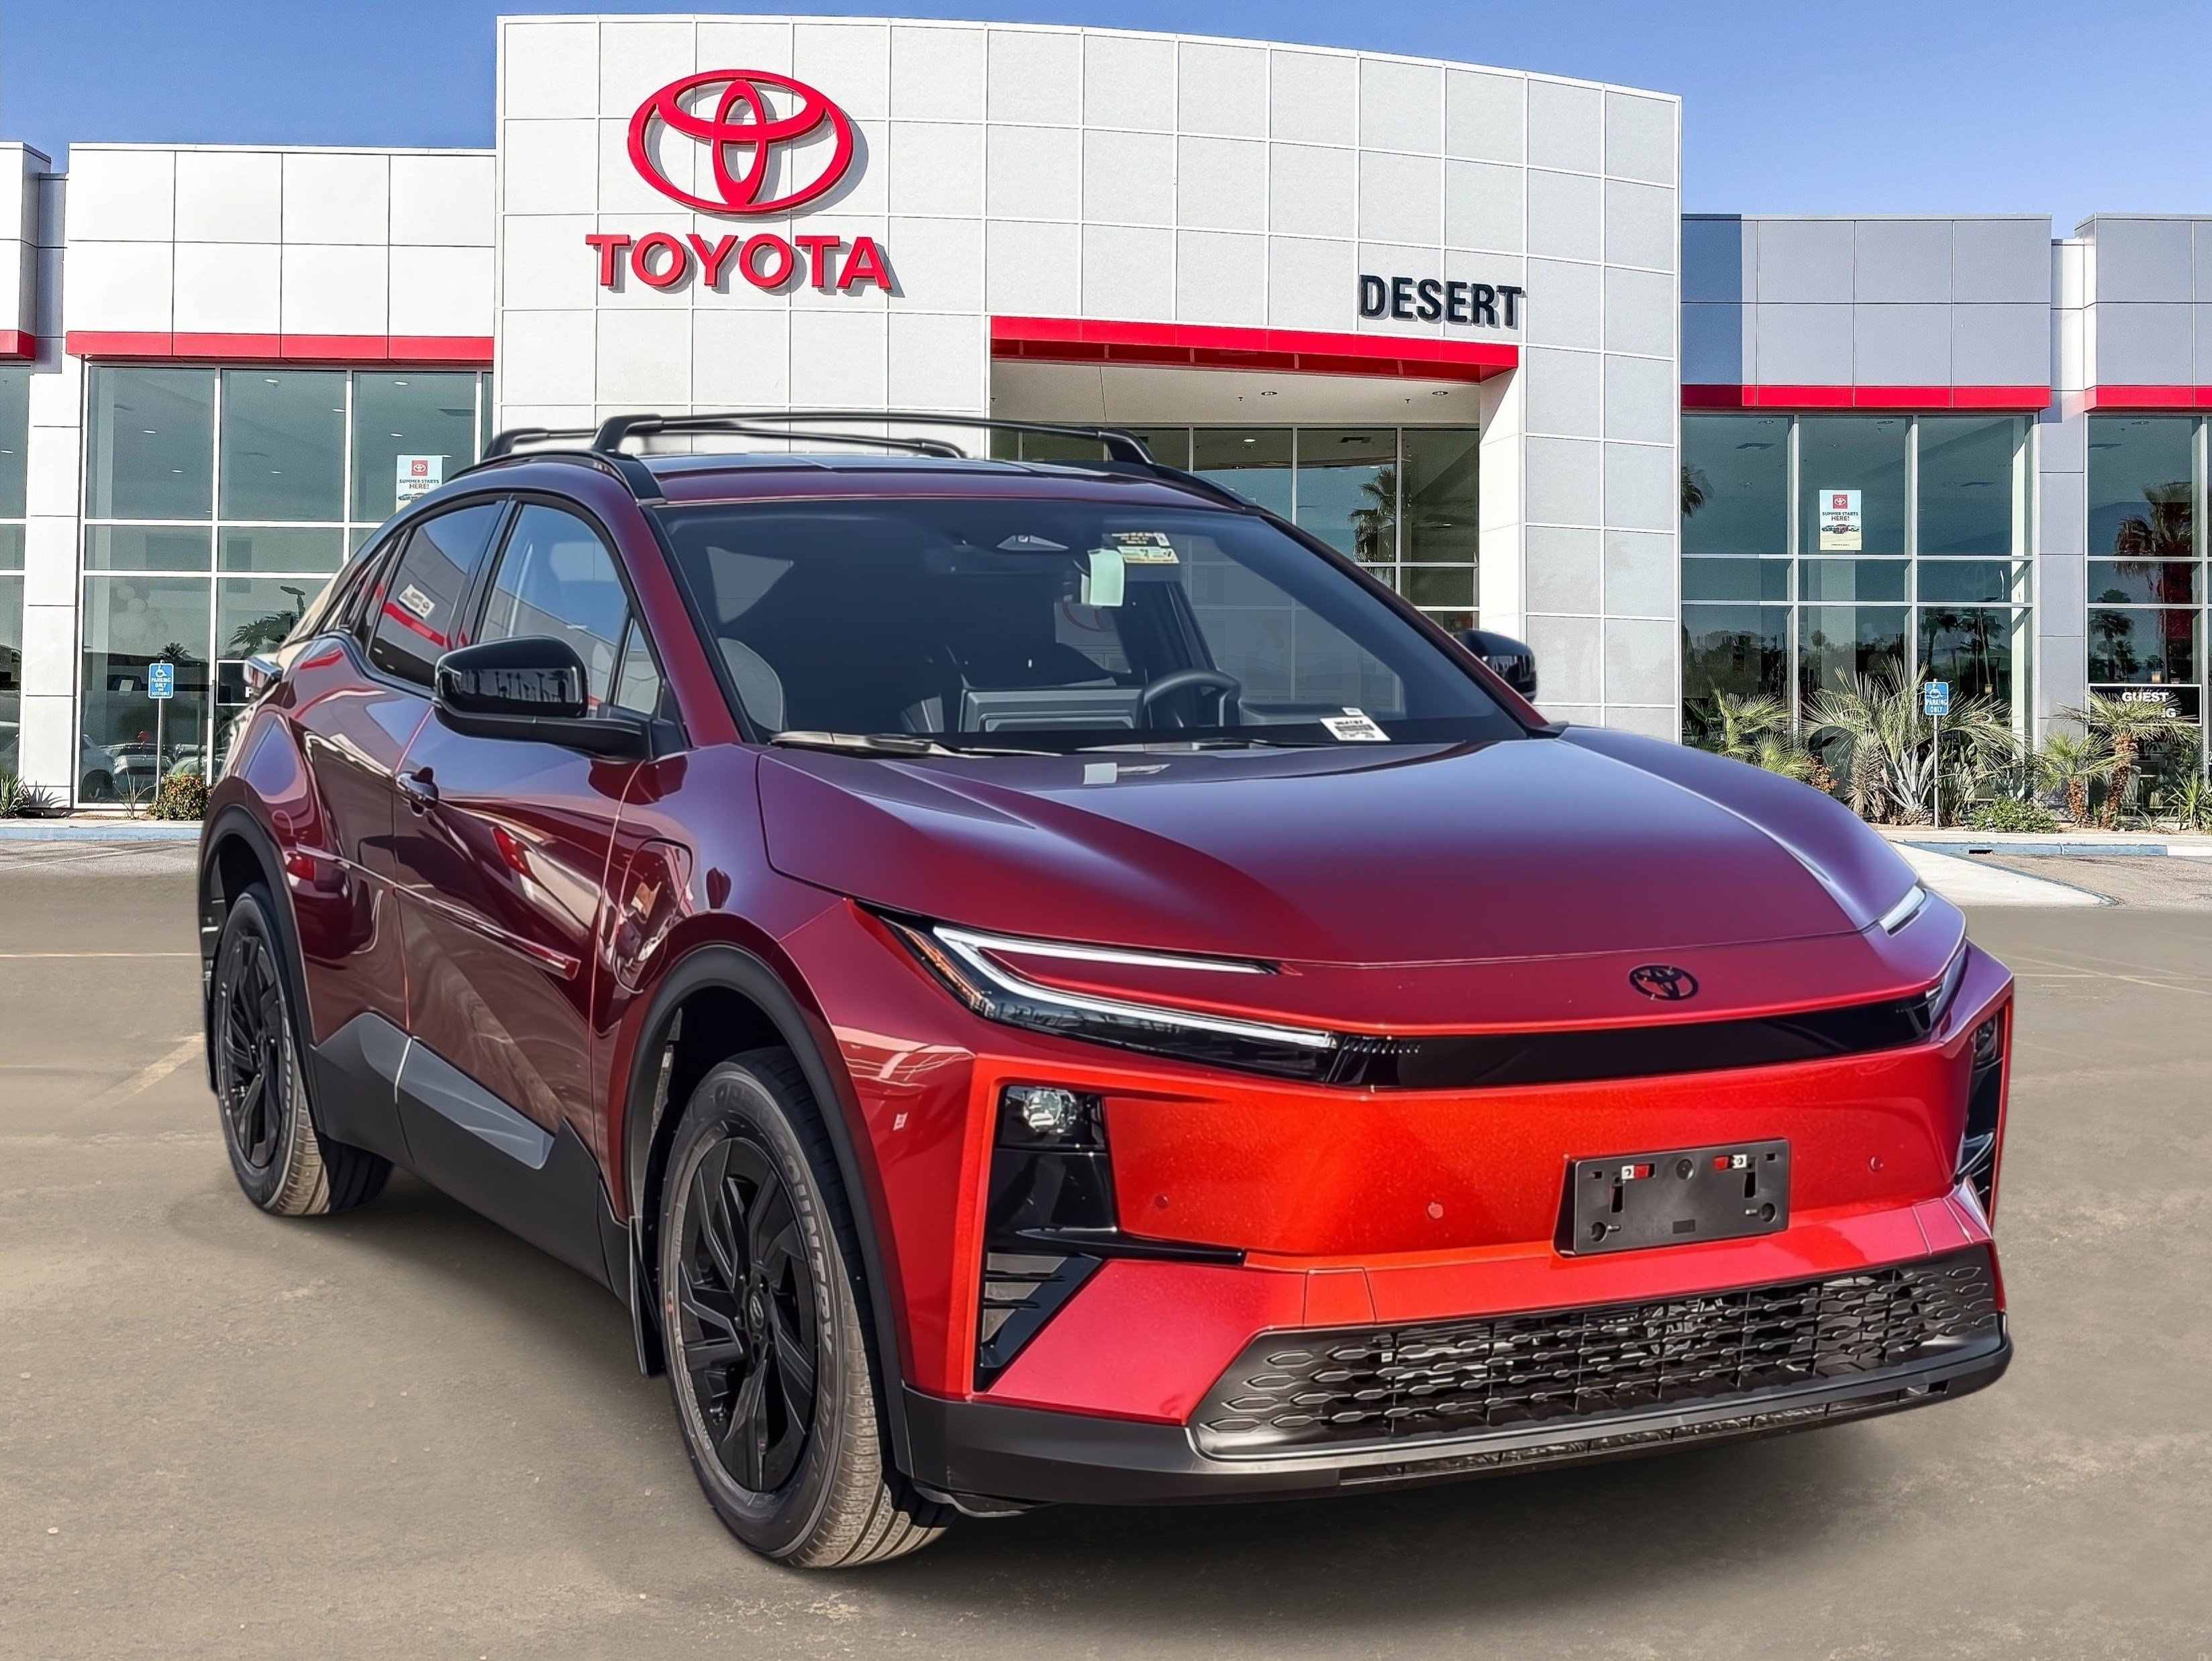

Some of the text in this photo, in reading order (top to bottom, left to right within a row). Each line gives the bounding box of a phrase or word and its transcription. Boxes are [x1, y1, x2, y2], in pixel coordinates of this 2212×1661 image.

[585, 232, 893, 291] TOYOTA
[1358, 274, 1523, 327] DESERT
[1926, 698, 1947, 706] PARKING
[2121, 691, 2169, 703] GUEST
[773, 1130, 833, 1356] COUNTRY
